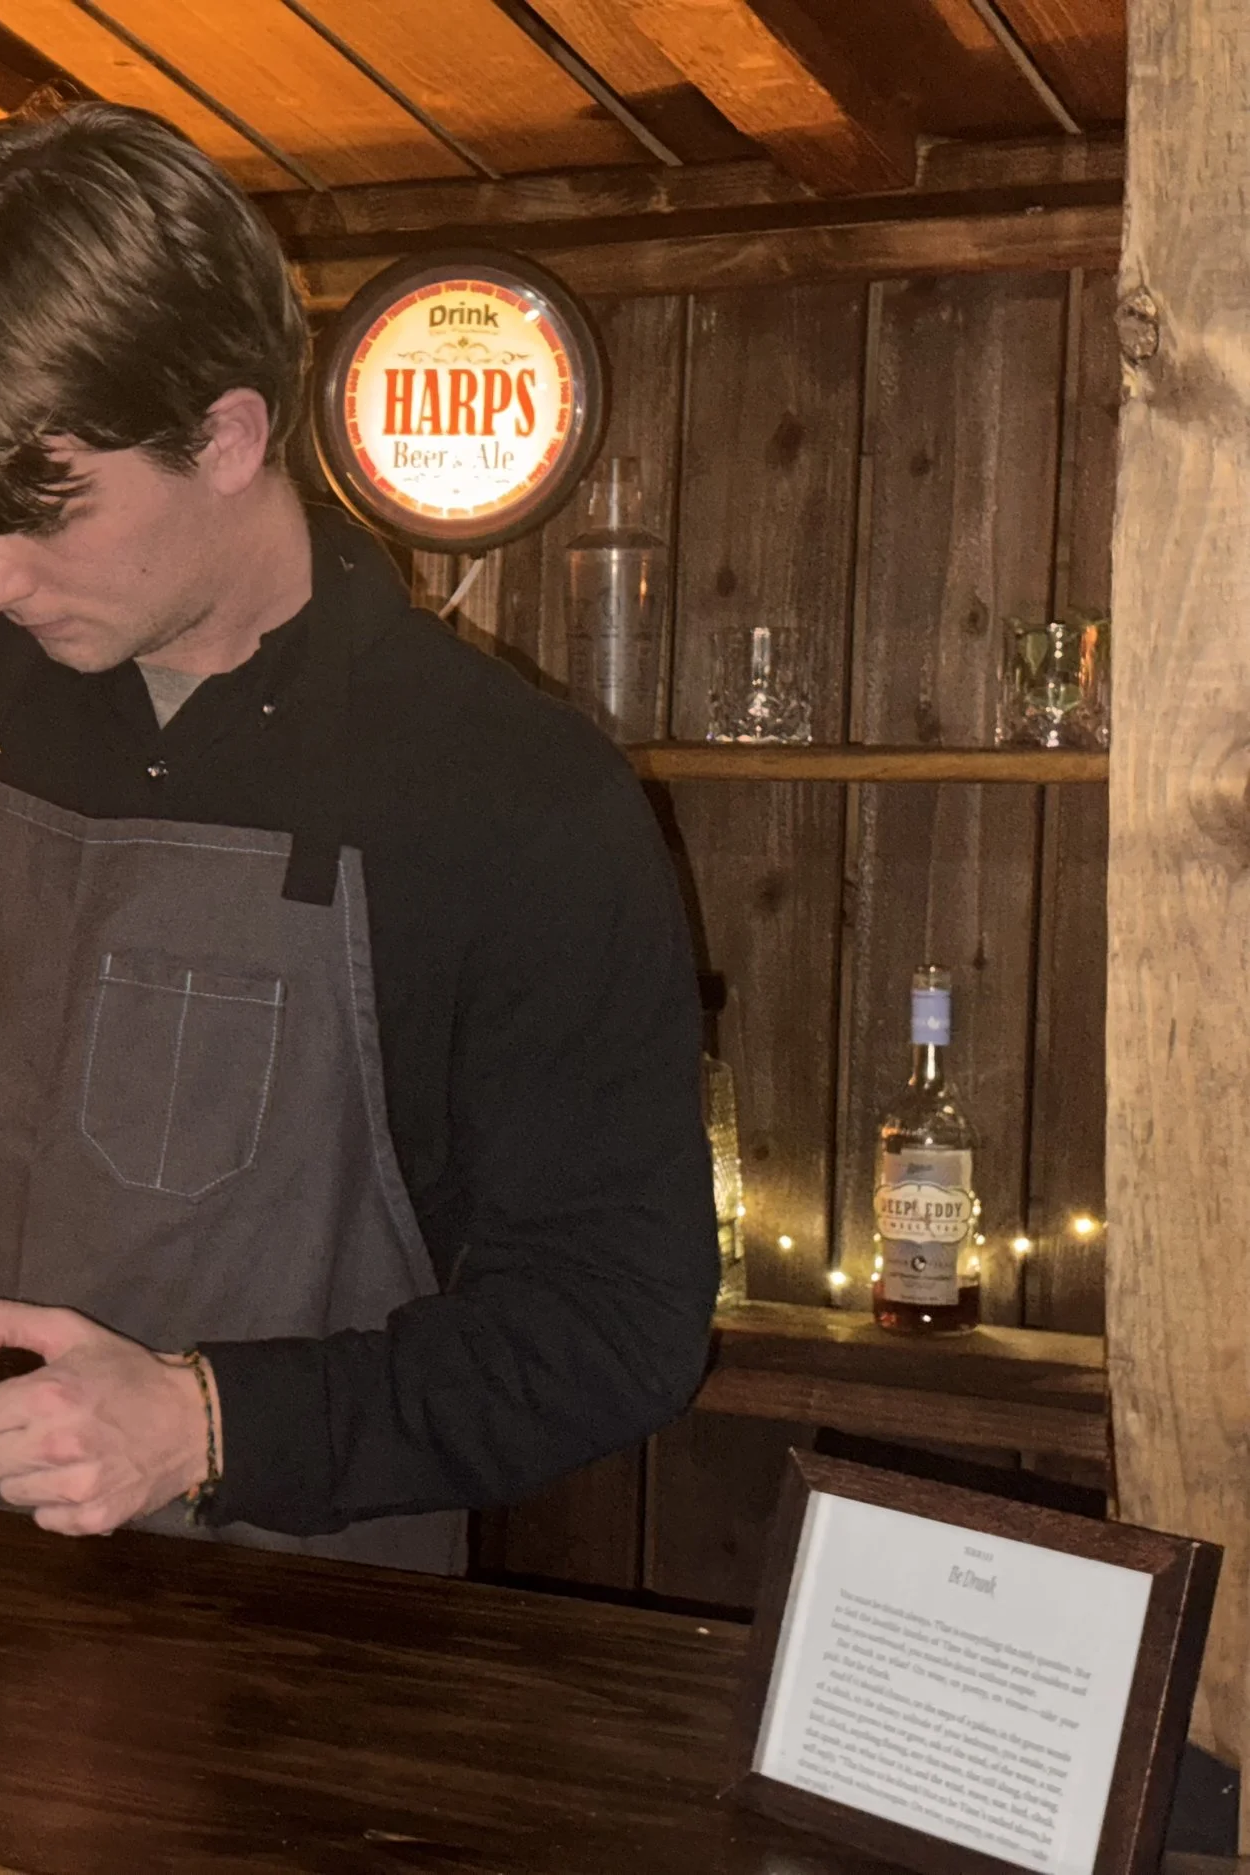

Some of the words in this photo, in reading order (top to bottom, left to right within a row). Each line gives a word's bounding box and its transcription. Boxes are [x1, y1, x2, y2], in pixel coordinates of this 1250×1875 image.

[429, 302, 499, 328] Drink
[382, 368, 536, 437] HARPS
[393, 440, 448, 468] Beer
[477, 441, 515, 469] Ale
[925, 1202, 963, 1218] EDDY
